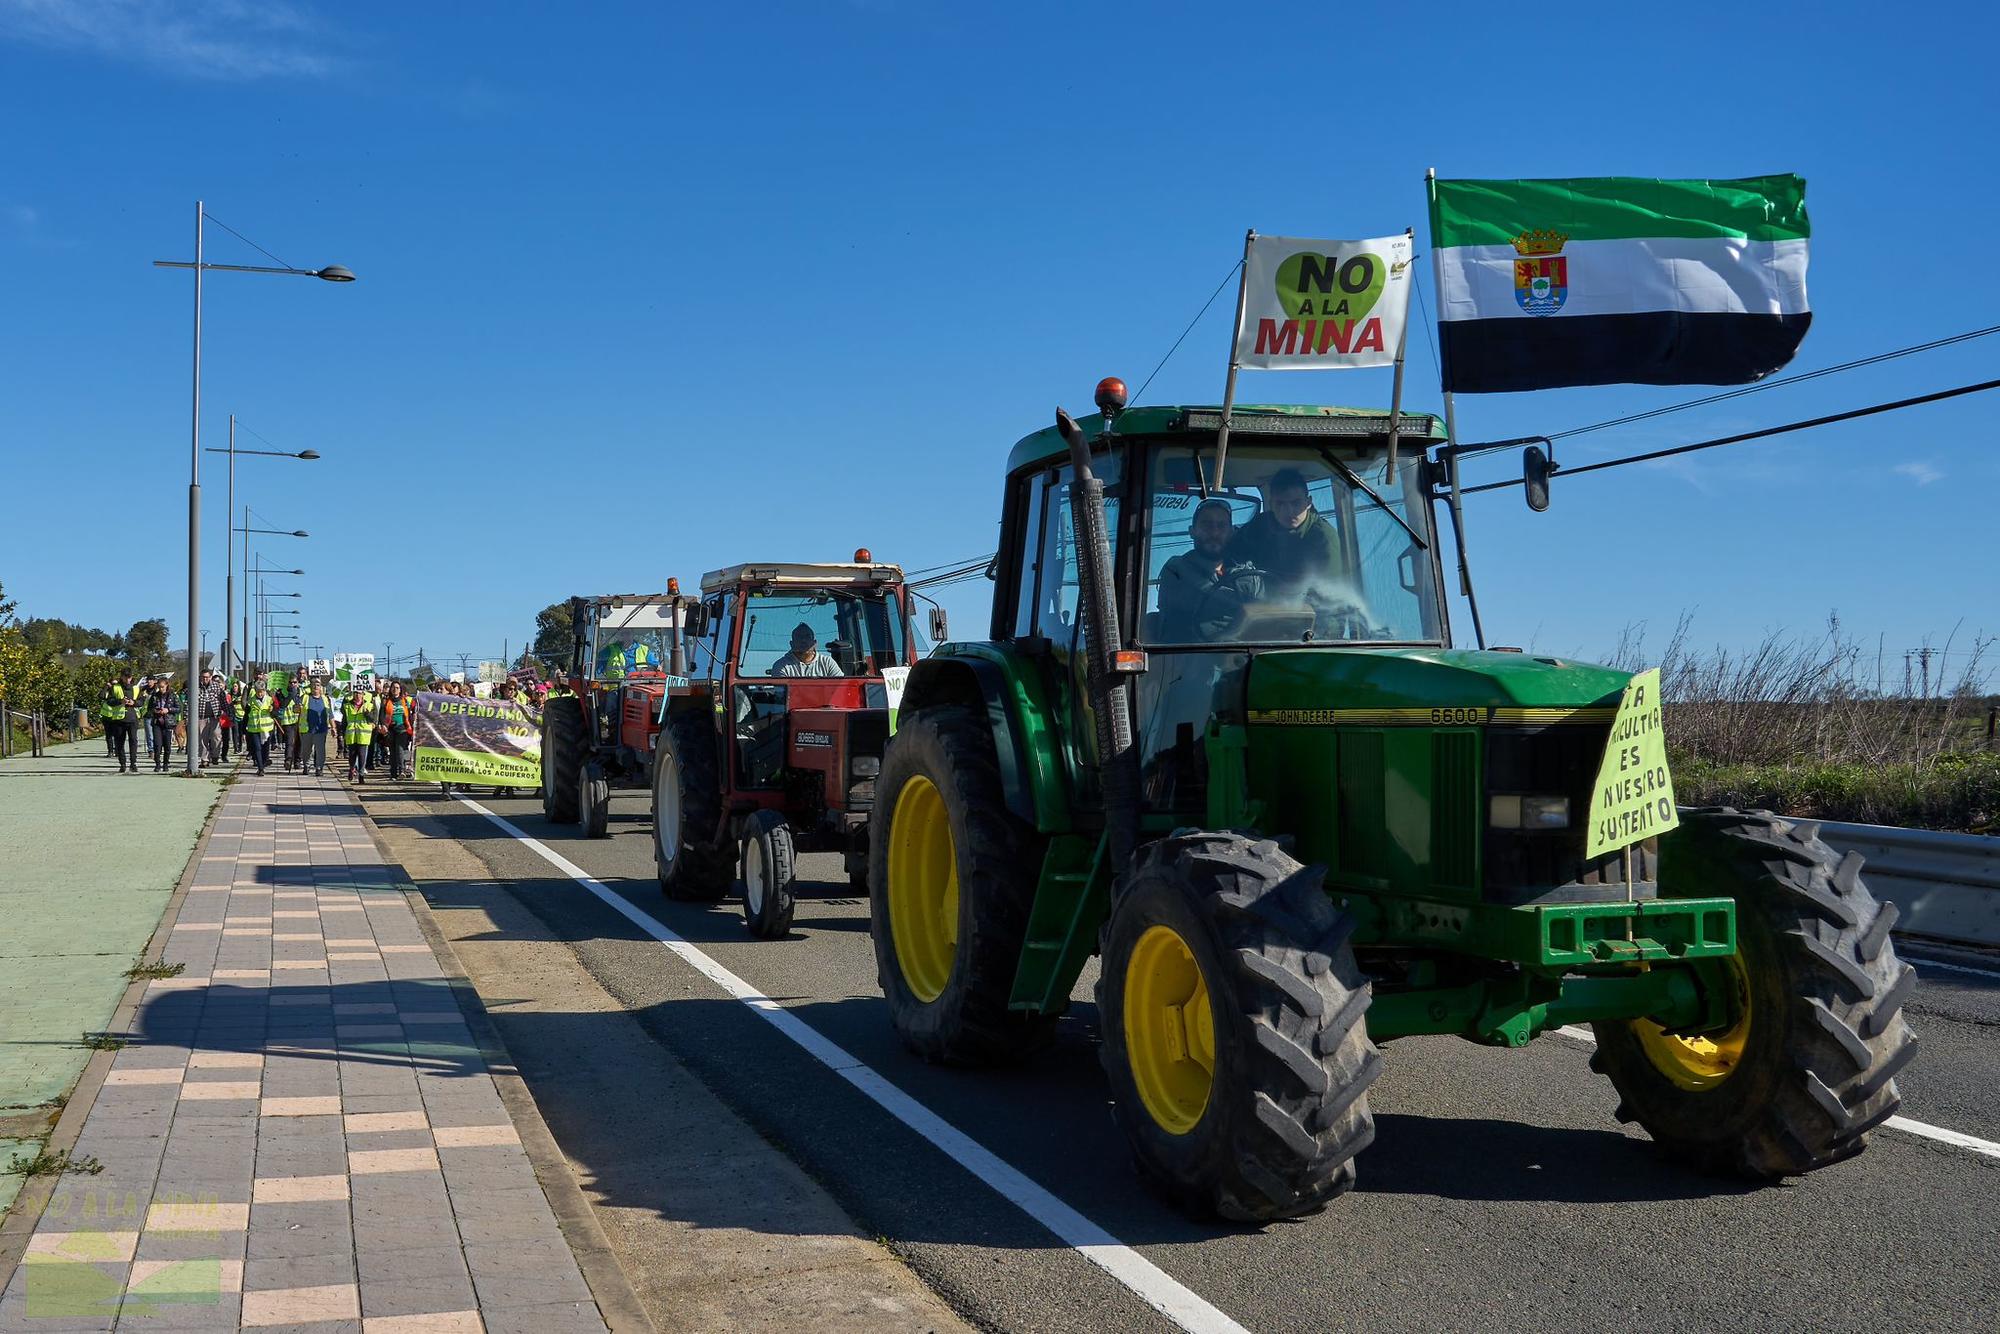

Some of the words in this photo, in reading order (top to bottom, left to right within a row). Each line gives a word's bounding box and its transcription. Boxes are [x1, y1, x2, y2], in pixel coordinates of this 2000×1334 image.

[1297, 255, 1374, 294] NO
[1299, 299, 1315, 315] A
[1322, 299, 1349, 315] LA
[1254, 318, 1384, 355] MINA
[1276, 710, 1300, 723] JOHN
[1302, 710, 1335, 724] DEERE
[1431, 708, 1479, 724] 6600
[1619, 745, 1641, 771] ES
[1598, 797, 1671, 846] SUSTENTO
